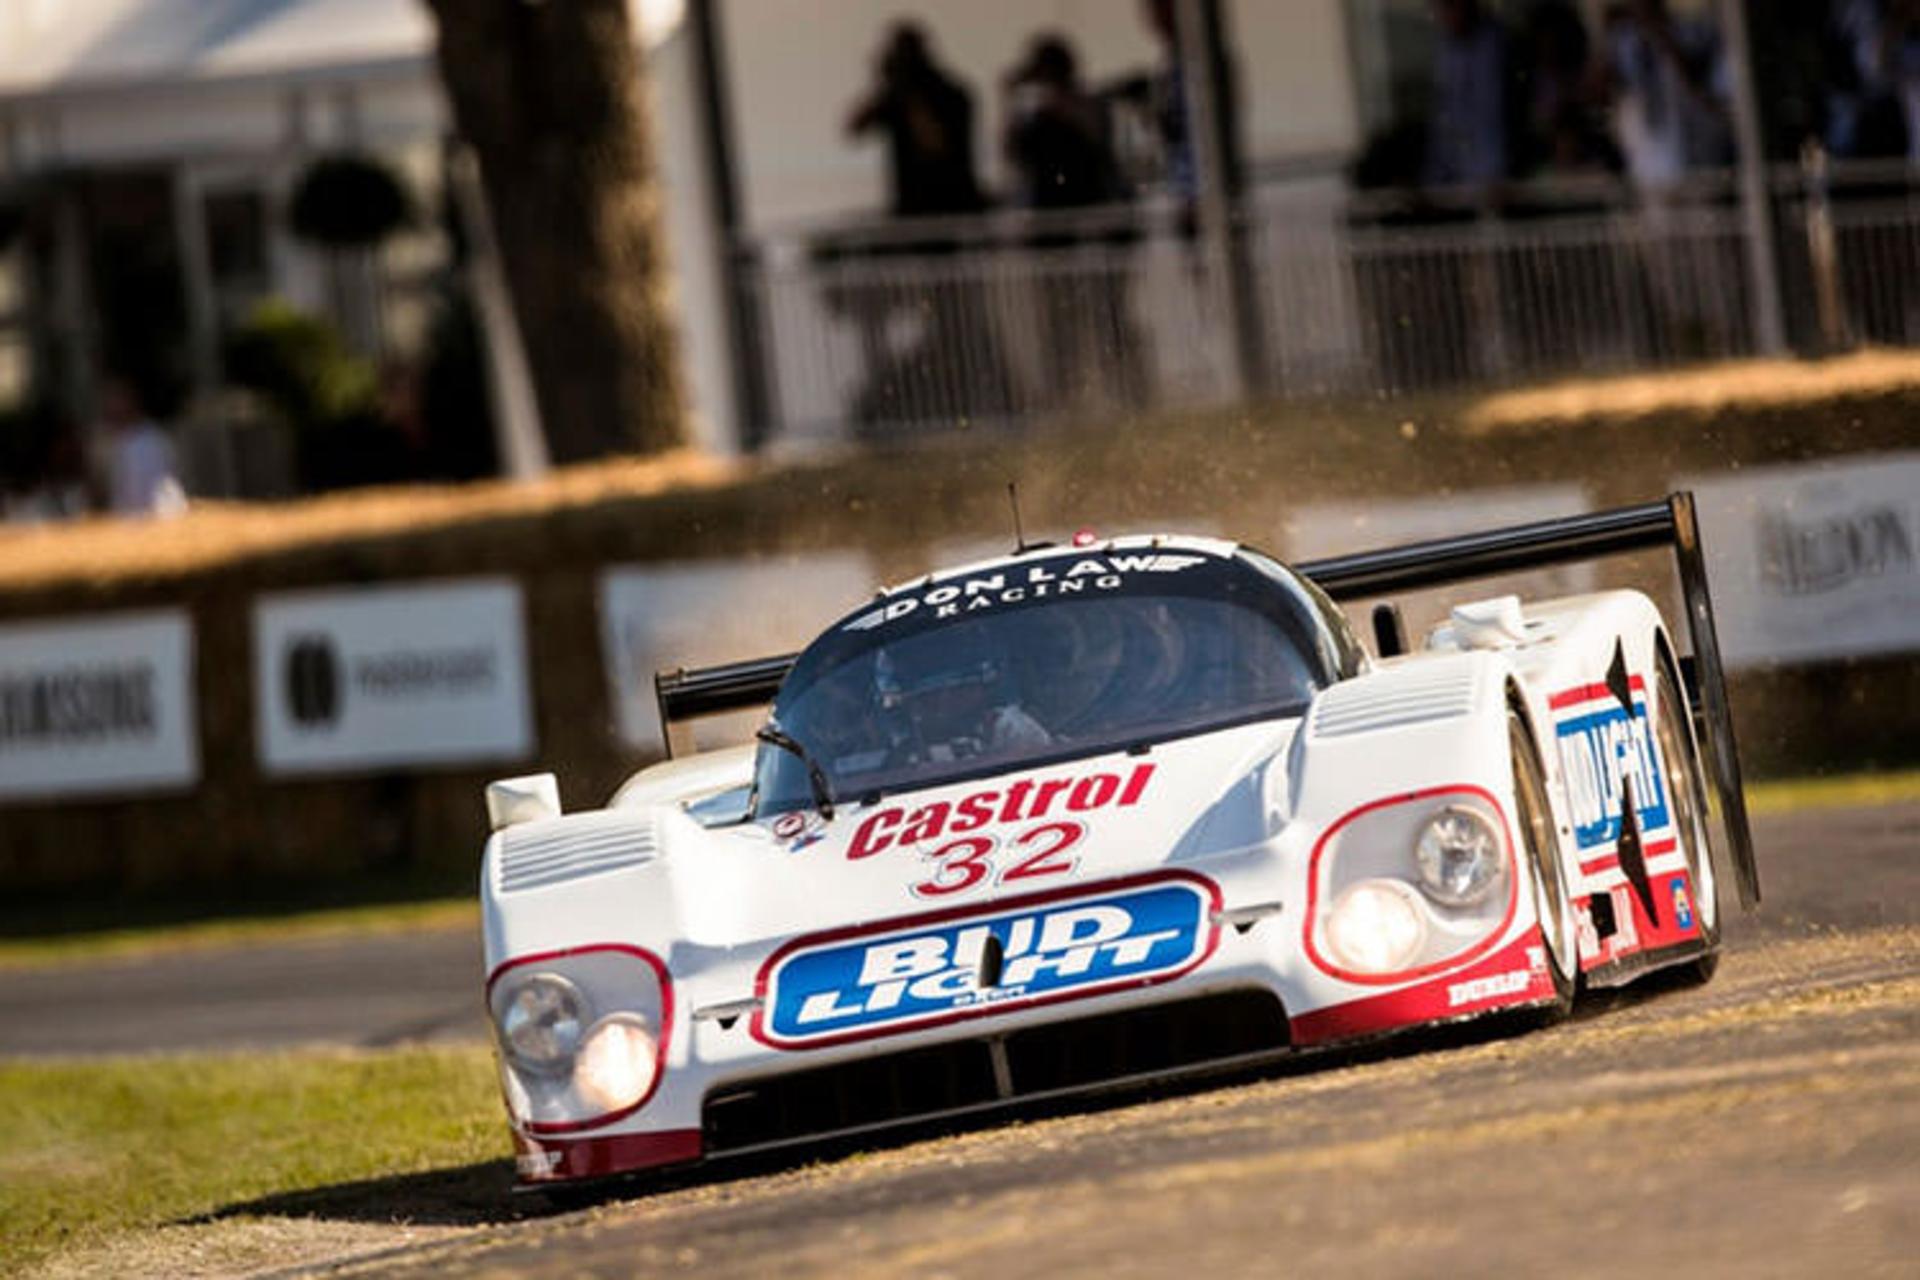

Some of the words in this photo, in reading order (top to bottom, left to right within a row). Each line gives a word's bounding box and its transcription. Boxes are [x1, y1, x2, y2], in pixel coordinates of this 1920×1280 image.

[885, 574, 1005, 620] DON
[1029, 555, 1154, 583] LAW
[935, 575, 1122, 618] RACING
[846, 764, 1156, 860] Castrol
[912, 820, 1087, 899] 32
[797, 929, 1180, 1024] LIGHT
[857, 905, 1133, 985] BUD
